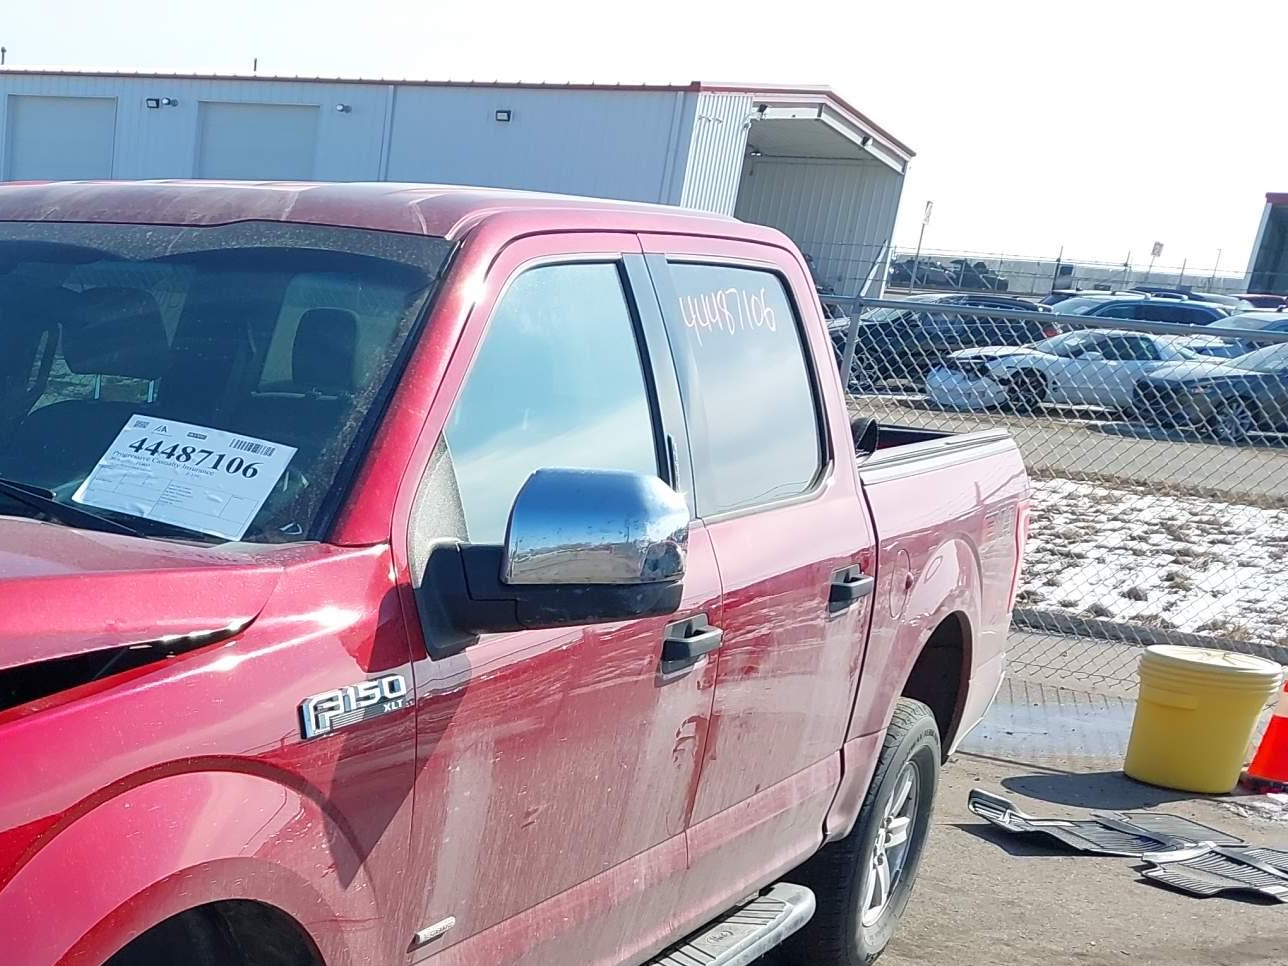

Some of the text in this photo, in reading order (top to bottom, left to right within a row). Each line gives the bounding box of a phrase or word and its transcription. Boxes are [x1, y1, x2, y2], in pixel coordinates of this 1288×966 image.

[679, 288, 776, 347] 44487106
[129, 437, 264, 479] 44487106
[383, 701, 404, 713] XLT
